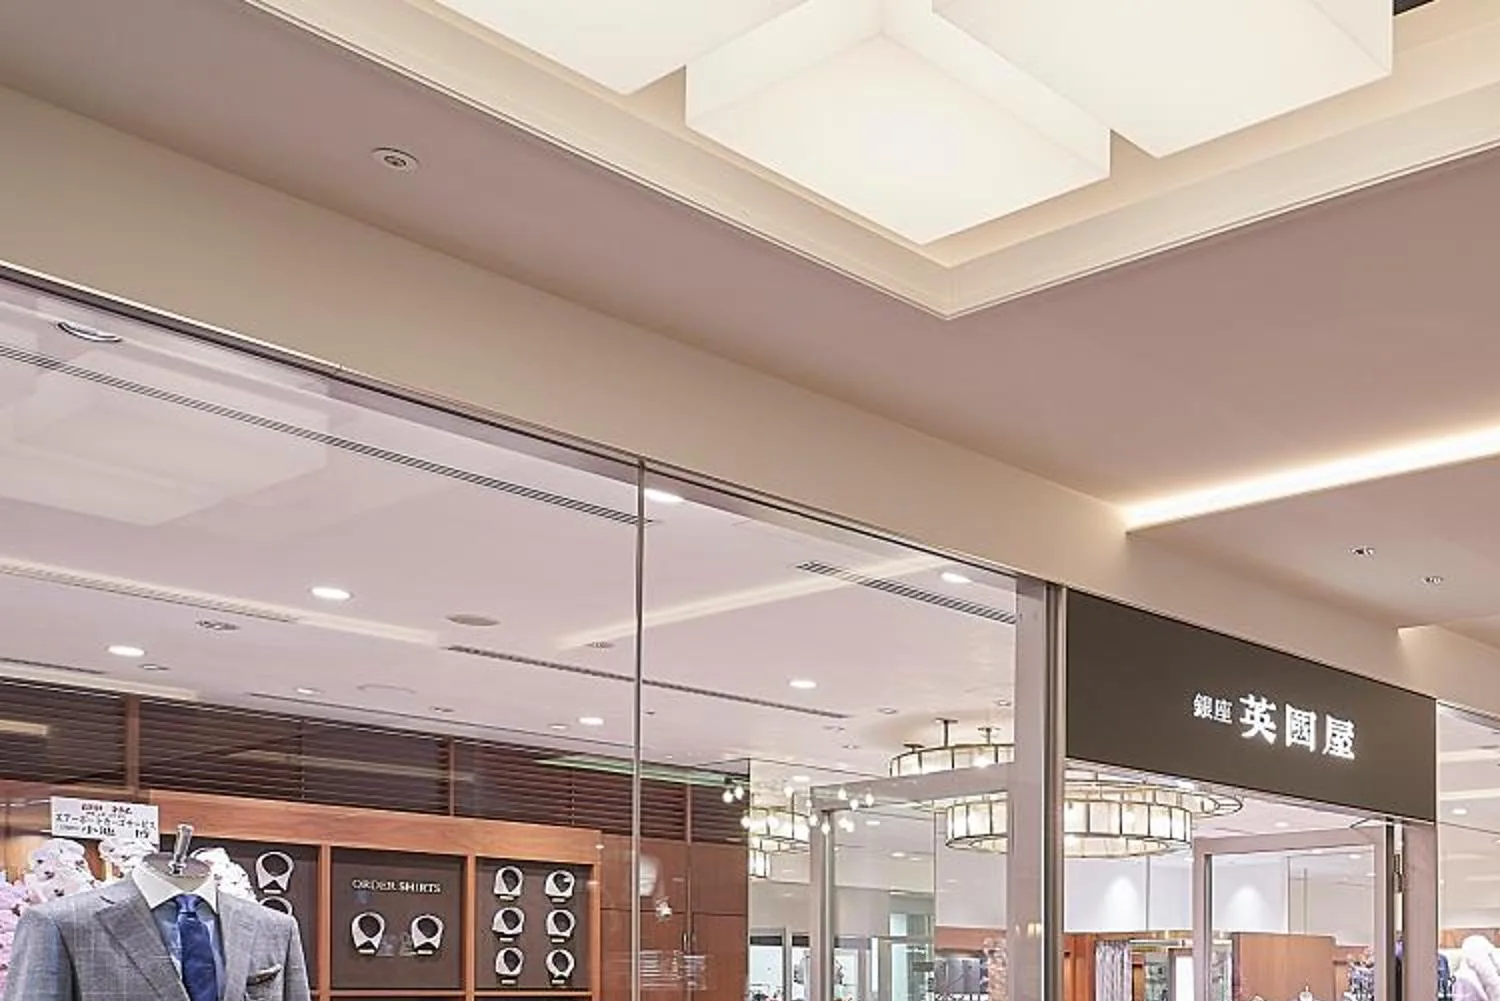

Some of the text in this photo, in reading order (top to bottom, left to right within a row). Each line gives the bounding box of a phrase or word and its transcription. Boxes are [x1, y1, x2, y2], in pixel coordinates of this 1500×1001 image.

[1193, 692, 1355, 760] 銀座 英國屋
[352, 879, 441, 894] ORDER SHIRTS
